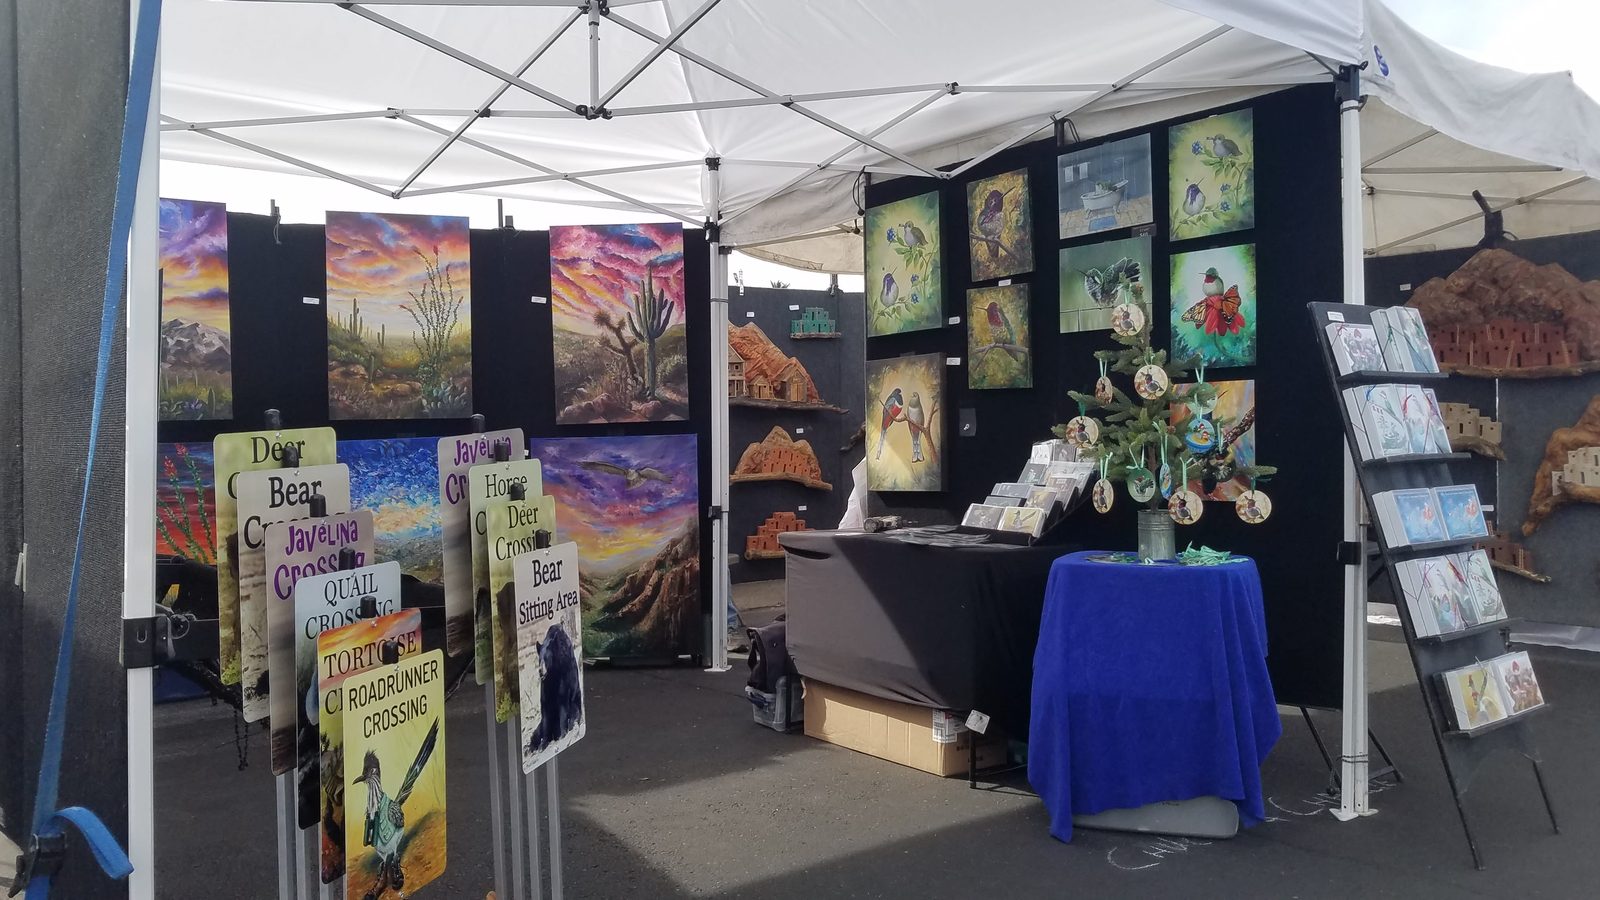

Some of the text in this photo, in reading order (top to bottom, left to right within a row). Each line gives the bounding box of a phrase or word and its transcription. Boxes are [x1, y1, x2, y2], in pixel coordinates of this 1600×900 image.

[268, 476, 322, 508] Bear
[508, 504, 539, 529] Deer
[496, 529, 552, 561] Crossi
[324, 573, 379, 607] QUAIL
[532, 559, 563, 588] Bear
[519, 589, 579, 625] Sitting Area
[323, 630, 417, 679] TORTOSE
[348, 659, 439, 712] ROADRUNNER
[363, 694, 428, 739] CROSSING
